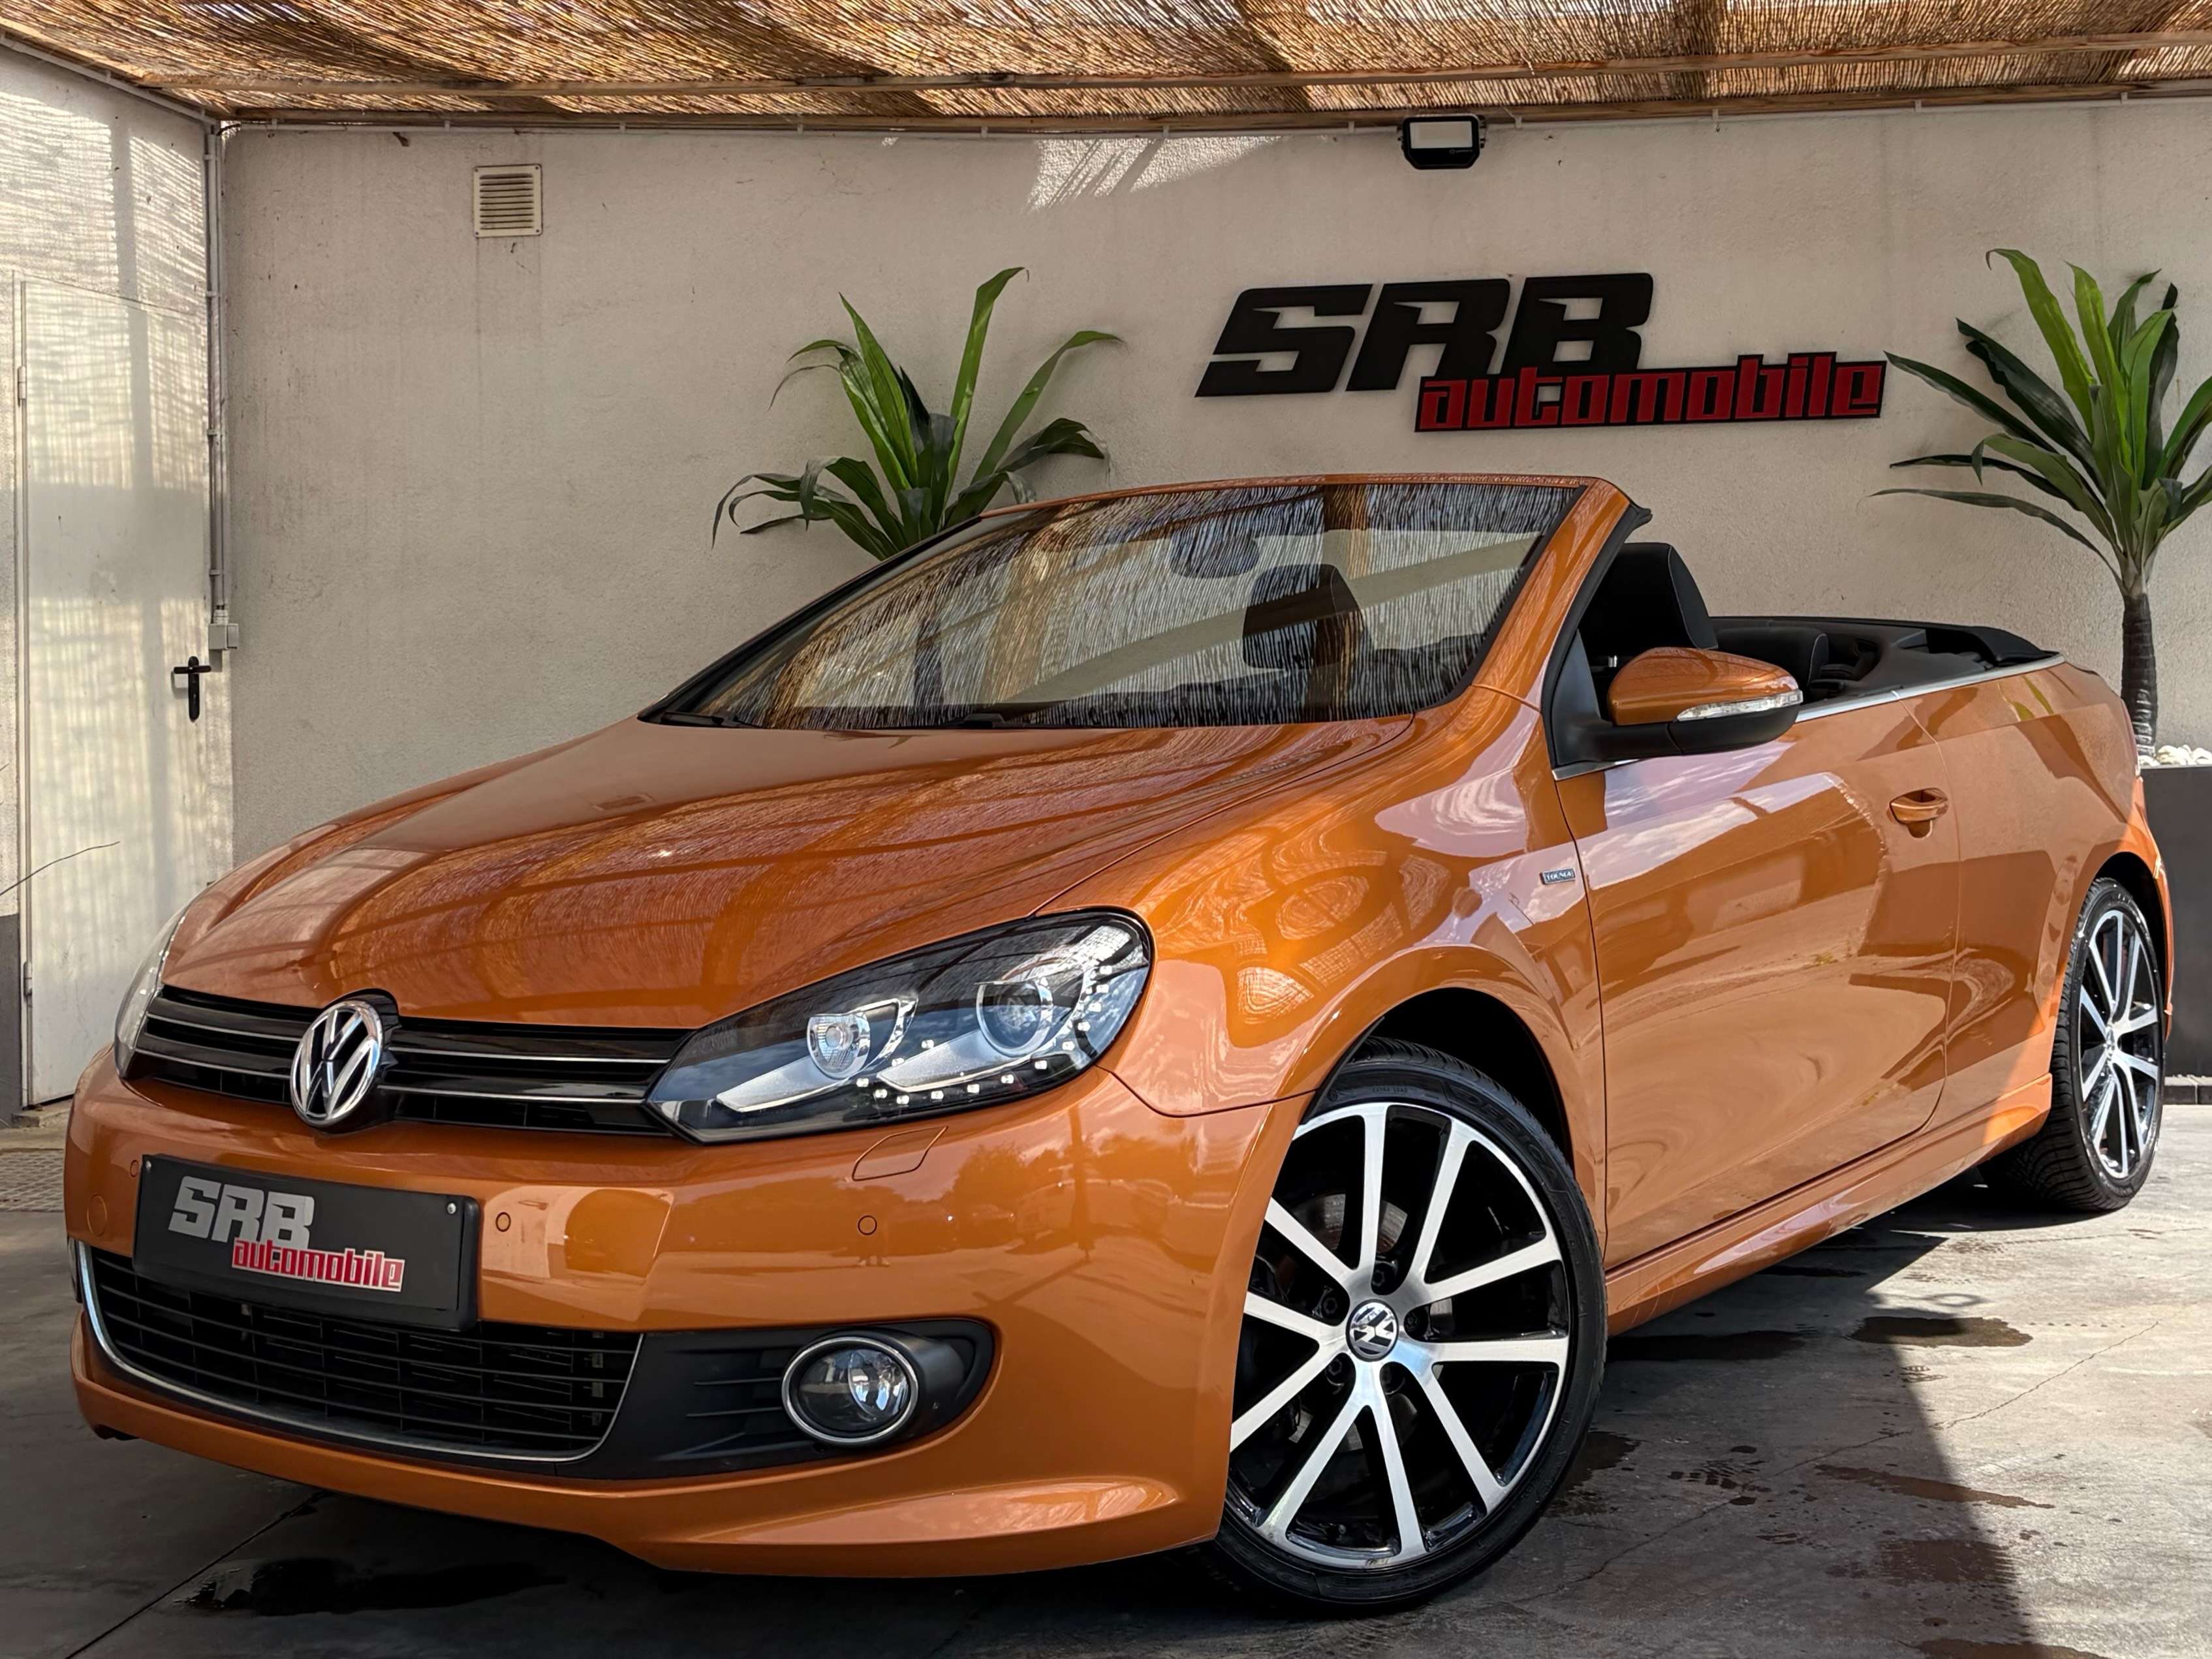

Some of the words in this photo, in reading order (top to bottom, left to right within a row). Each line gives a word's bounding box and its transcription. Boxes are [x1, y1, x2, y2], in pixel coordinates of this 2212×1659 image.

[1194, 273, 1653, 397] SRB
[1414, 352, 1886, 432] automobile
[290, 1000, 383, 1126] VW
[168, 1175, 315, 1248] SRB
[232, 1238, 405, 1292] automobile
[1349, 1301, 1398, 1359] VW
